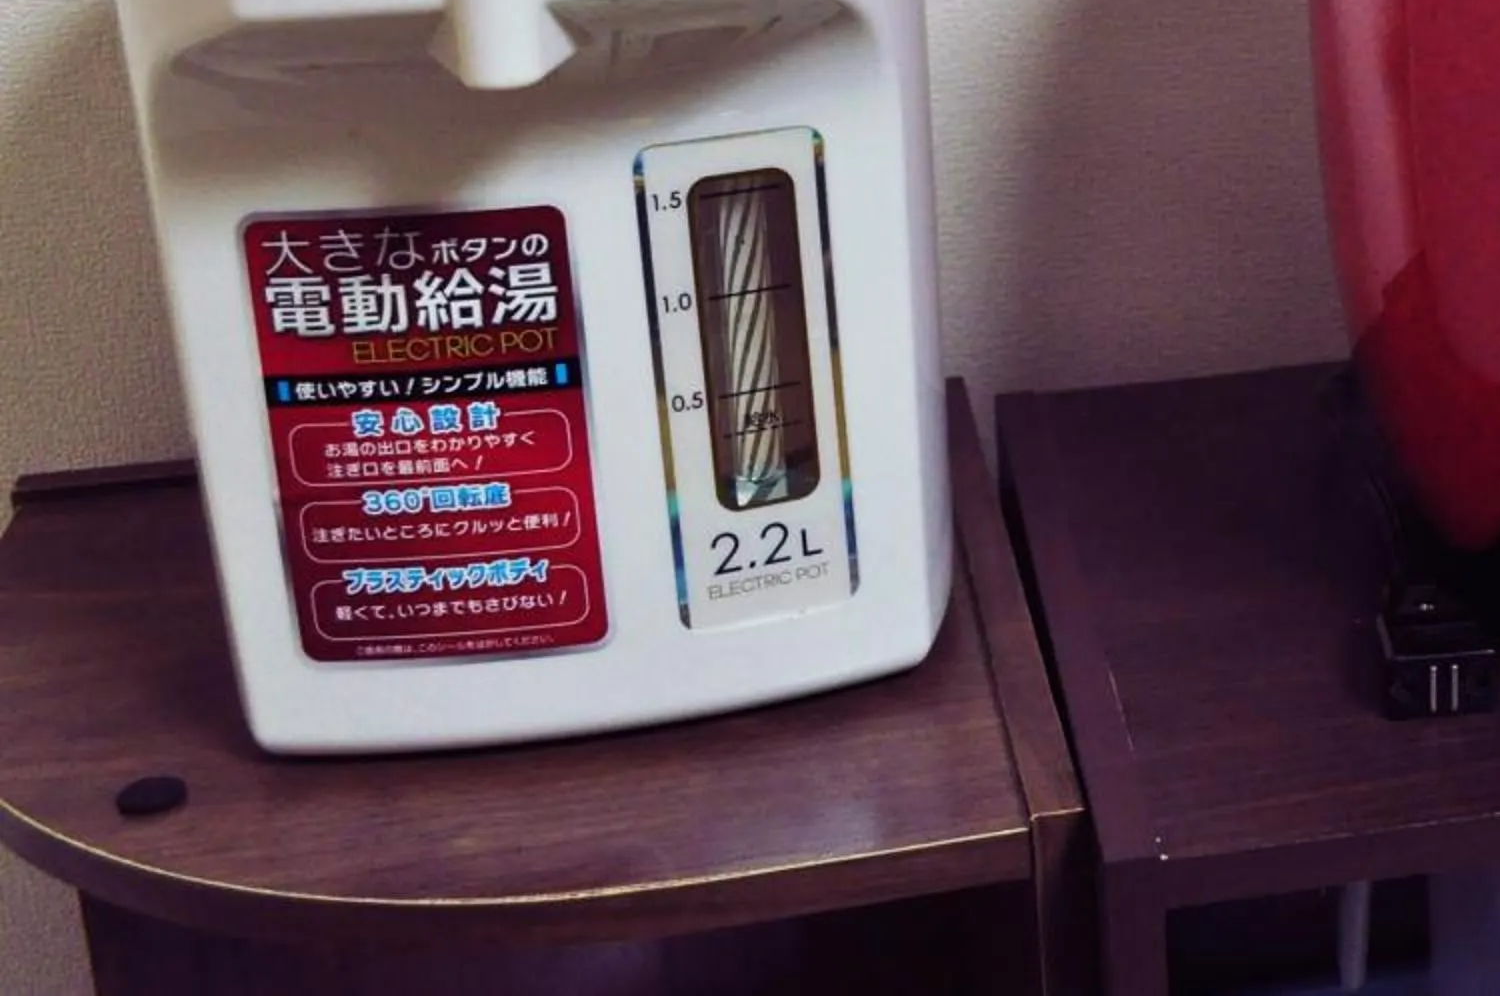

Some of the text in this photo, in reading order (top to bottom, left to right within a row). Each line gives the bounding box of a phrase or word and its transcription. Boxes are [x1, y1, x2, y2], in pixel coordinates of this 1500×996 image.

[650, 192, 683, 212] 1.5
[261, 225, 549, 275] 大きなボタンの
[264, 261, 560, 337] 電動給湯
[661, 292, 693, 313] 1.0
[352, 327, 559, 364] ELECTRIC POT
[352, 401, 501, 438] 安心設計
[671, 393, 704, 413] 0.5
[324, 431, 535, 459] お湯の出口をわかりやすく
[342, 557, 549, 594] プラスティックボディ
[709, 564, 829, 601] ELECTRIC POT
